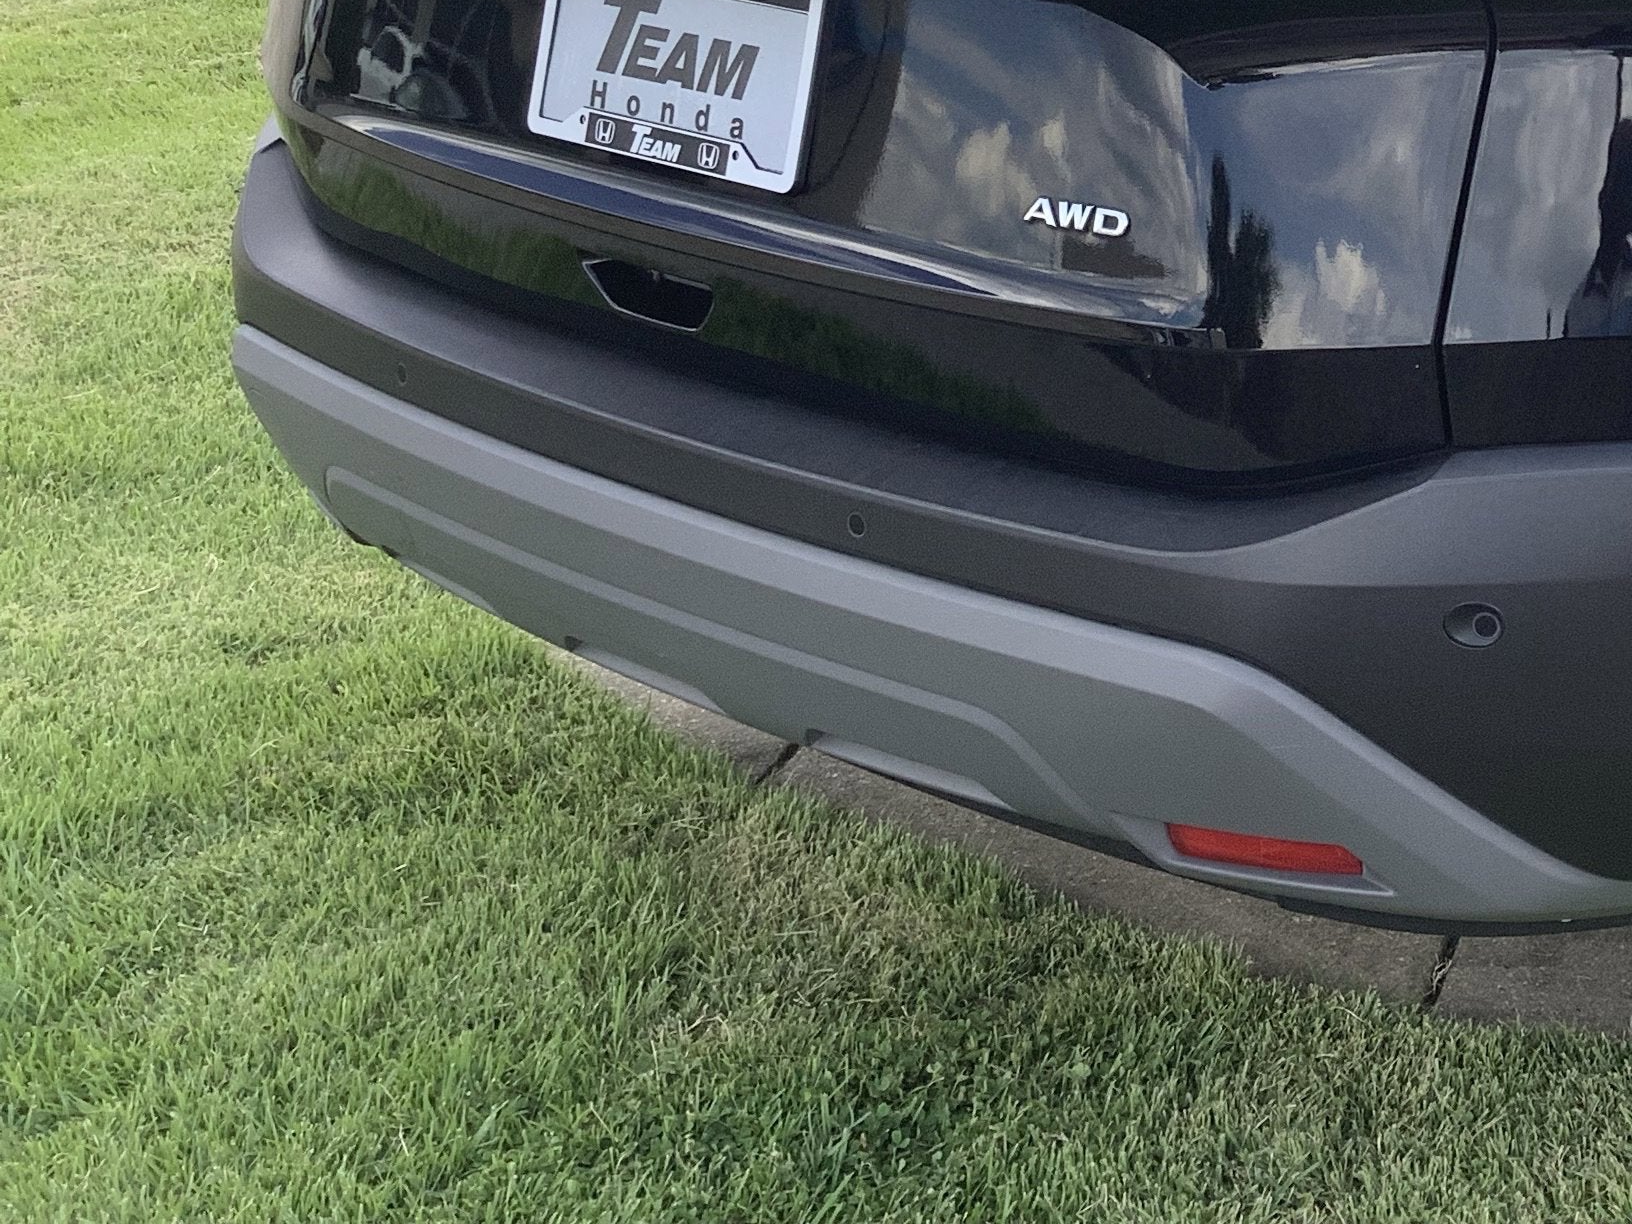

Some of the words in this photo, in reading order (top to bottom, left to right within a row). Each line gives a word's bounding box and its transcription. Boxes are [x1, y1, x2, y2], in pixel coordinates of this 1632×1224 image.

[590, 79, 744, 139] Honda
[630, 124, 682, 163] TEAM
[1023, 197, 1129, 237] AWD
